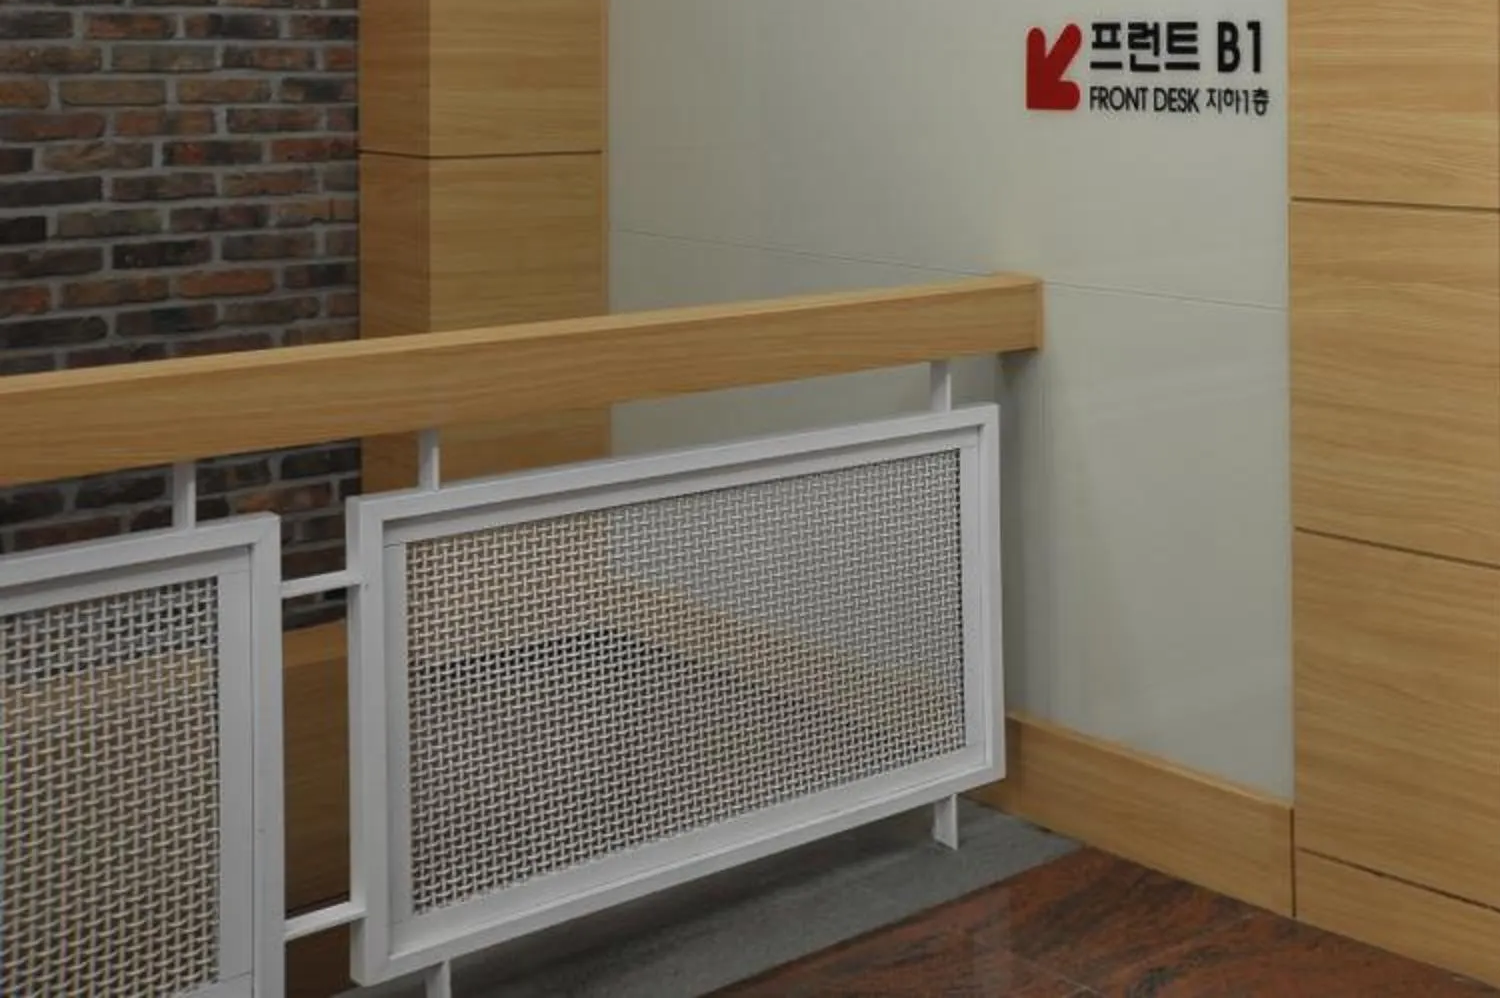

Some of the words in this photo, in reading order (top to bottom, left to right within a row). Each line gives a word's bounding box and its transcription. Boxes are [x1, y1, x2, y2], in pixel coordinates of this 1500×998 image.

[1089, 20, 1201, 74] 프런트
[1215, 19, 1263, 74] B1
[1089, 84, 1150, 112] FRONT
[1152, 86, 1201, 114] DESK
